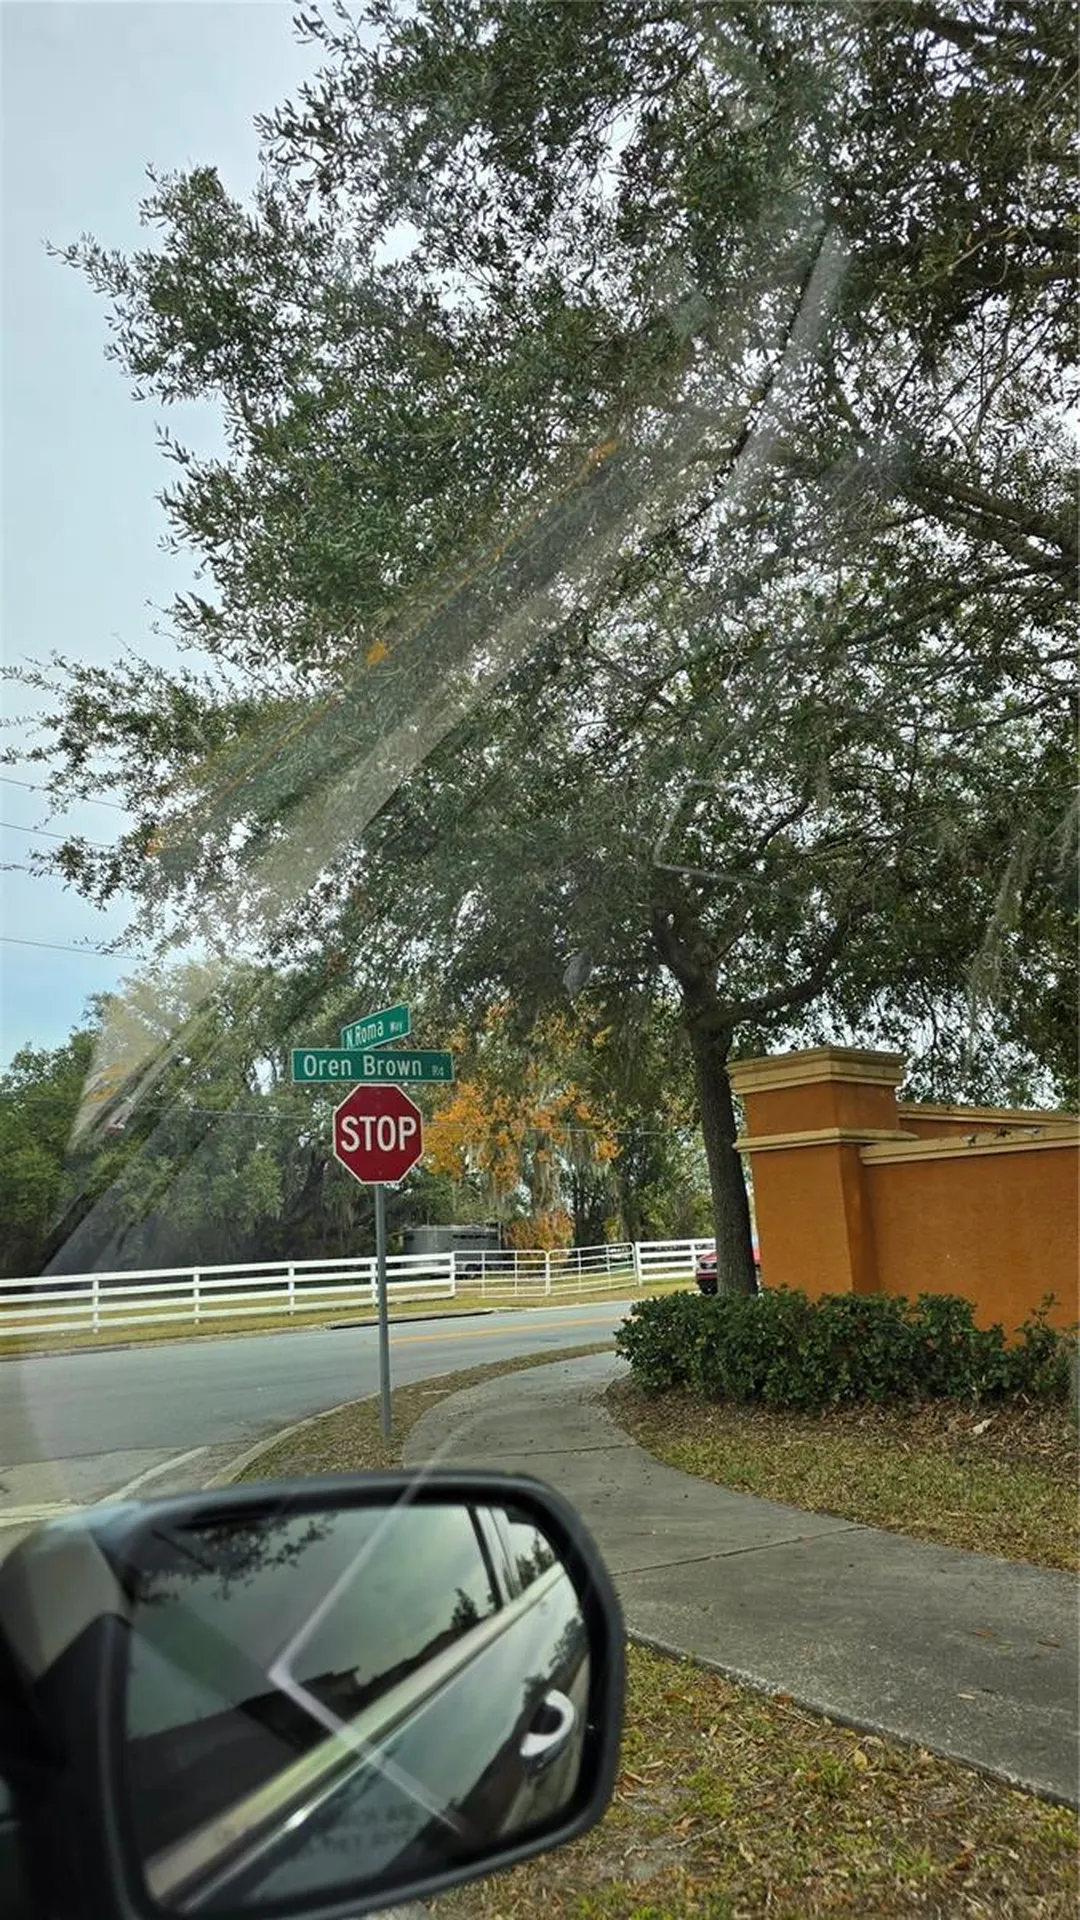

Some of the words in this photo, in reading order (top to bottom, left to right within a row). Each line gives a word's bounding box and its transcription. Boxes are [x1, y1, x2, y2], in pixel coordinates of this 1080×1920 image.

[355, 1021, 384, 1046] Roma
[303, 1055, 352, 1076] Oren
[363, 1055, 422, 1076] Brown
[432, 1065, 444, 1076] Rd
[341, 1116, 416, 1152] STOP
